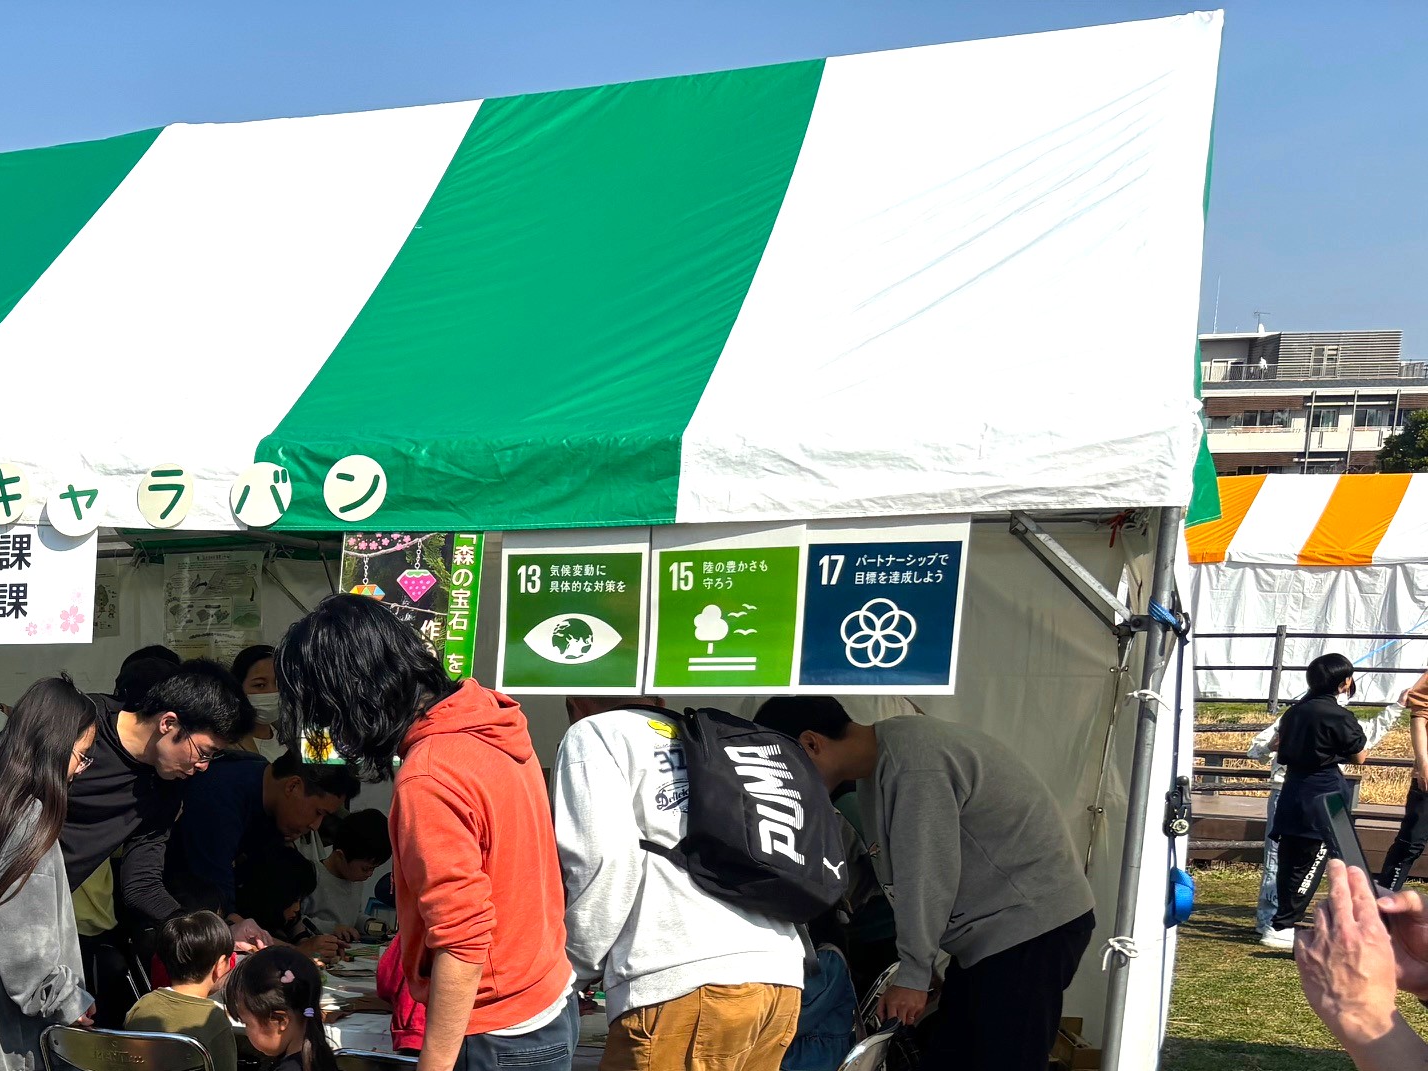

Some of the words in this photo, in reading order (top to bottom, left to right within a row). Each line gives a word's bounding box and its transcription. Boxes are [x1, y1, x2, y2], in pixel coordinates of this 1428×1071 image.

[702, 560, 769, 574] 陸の豊かさも
[855, 552, 949, 568] パートナーシップで
[549, 563, 607, 577] 気候変動に
[669, 561, 694, 591] 15
[818, 554, 845, 585] 17
[854, 569, 944, 585] 目標を達成しよう
[517, 564, 541, 594] 13
[549, 580, 626, 593] 具体的な対策を
[702, 577, 733, 590] 守ろう
[723, 744, 805, 866] PUMA
